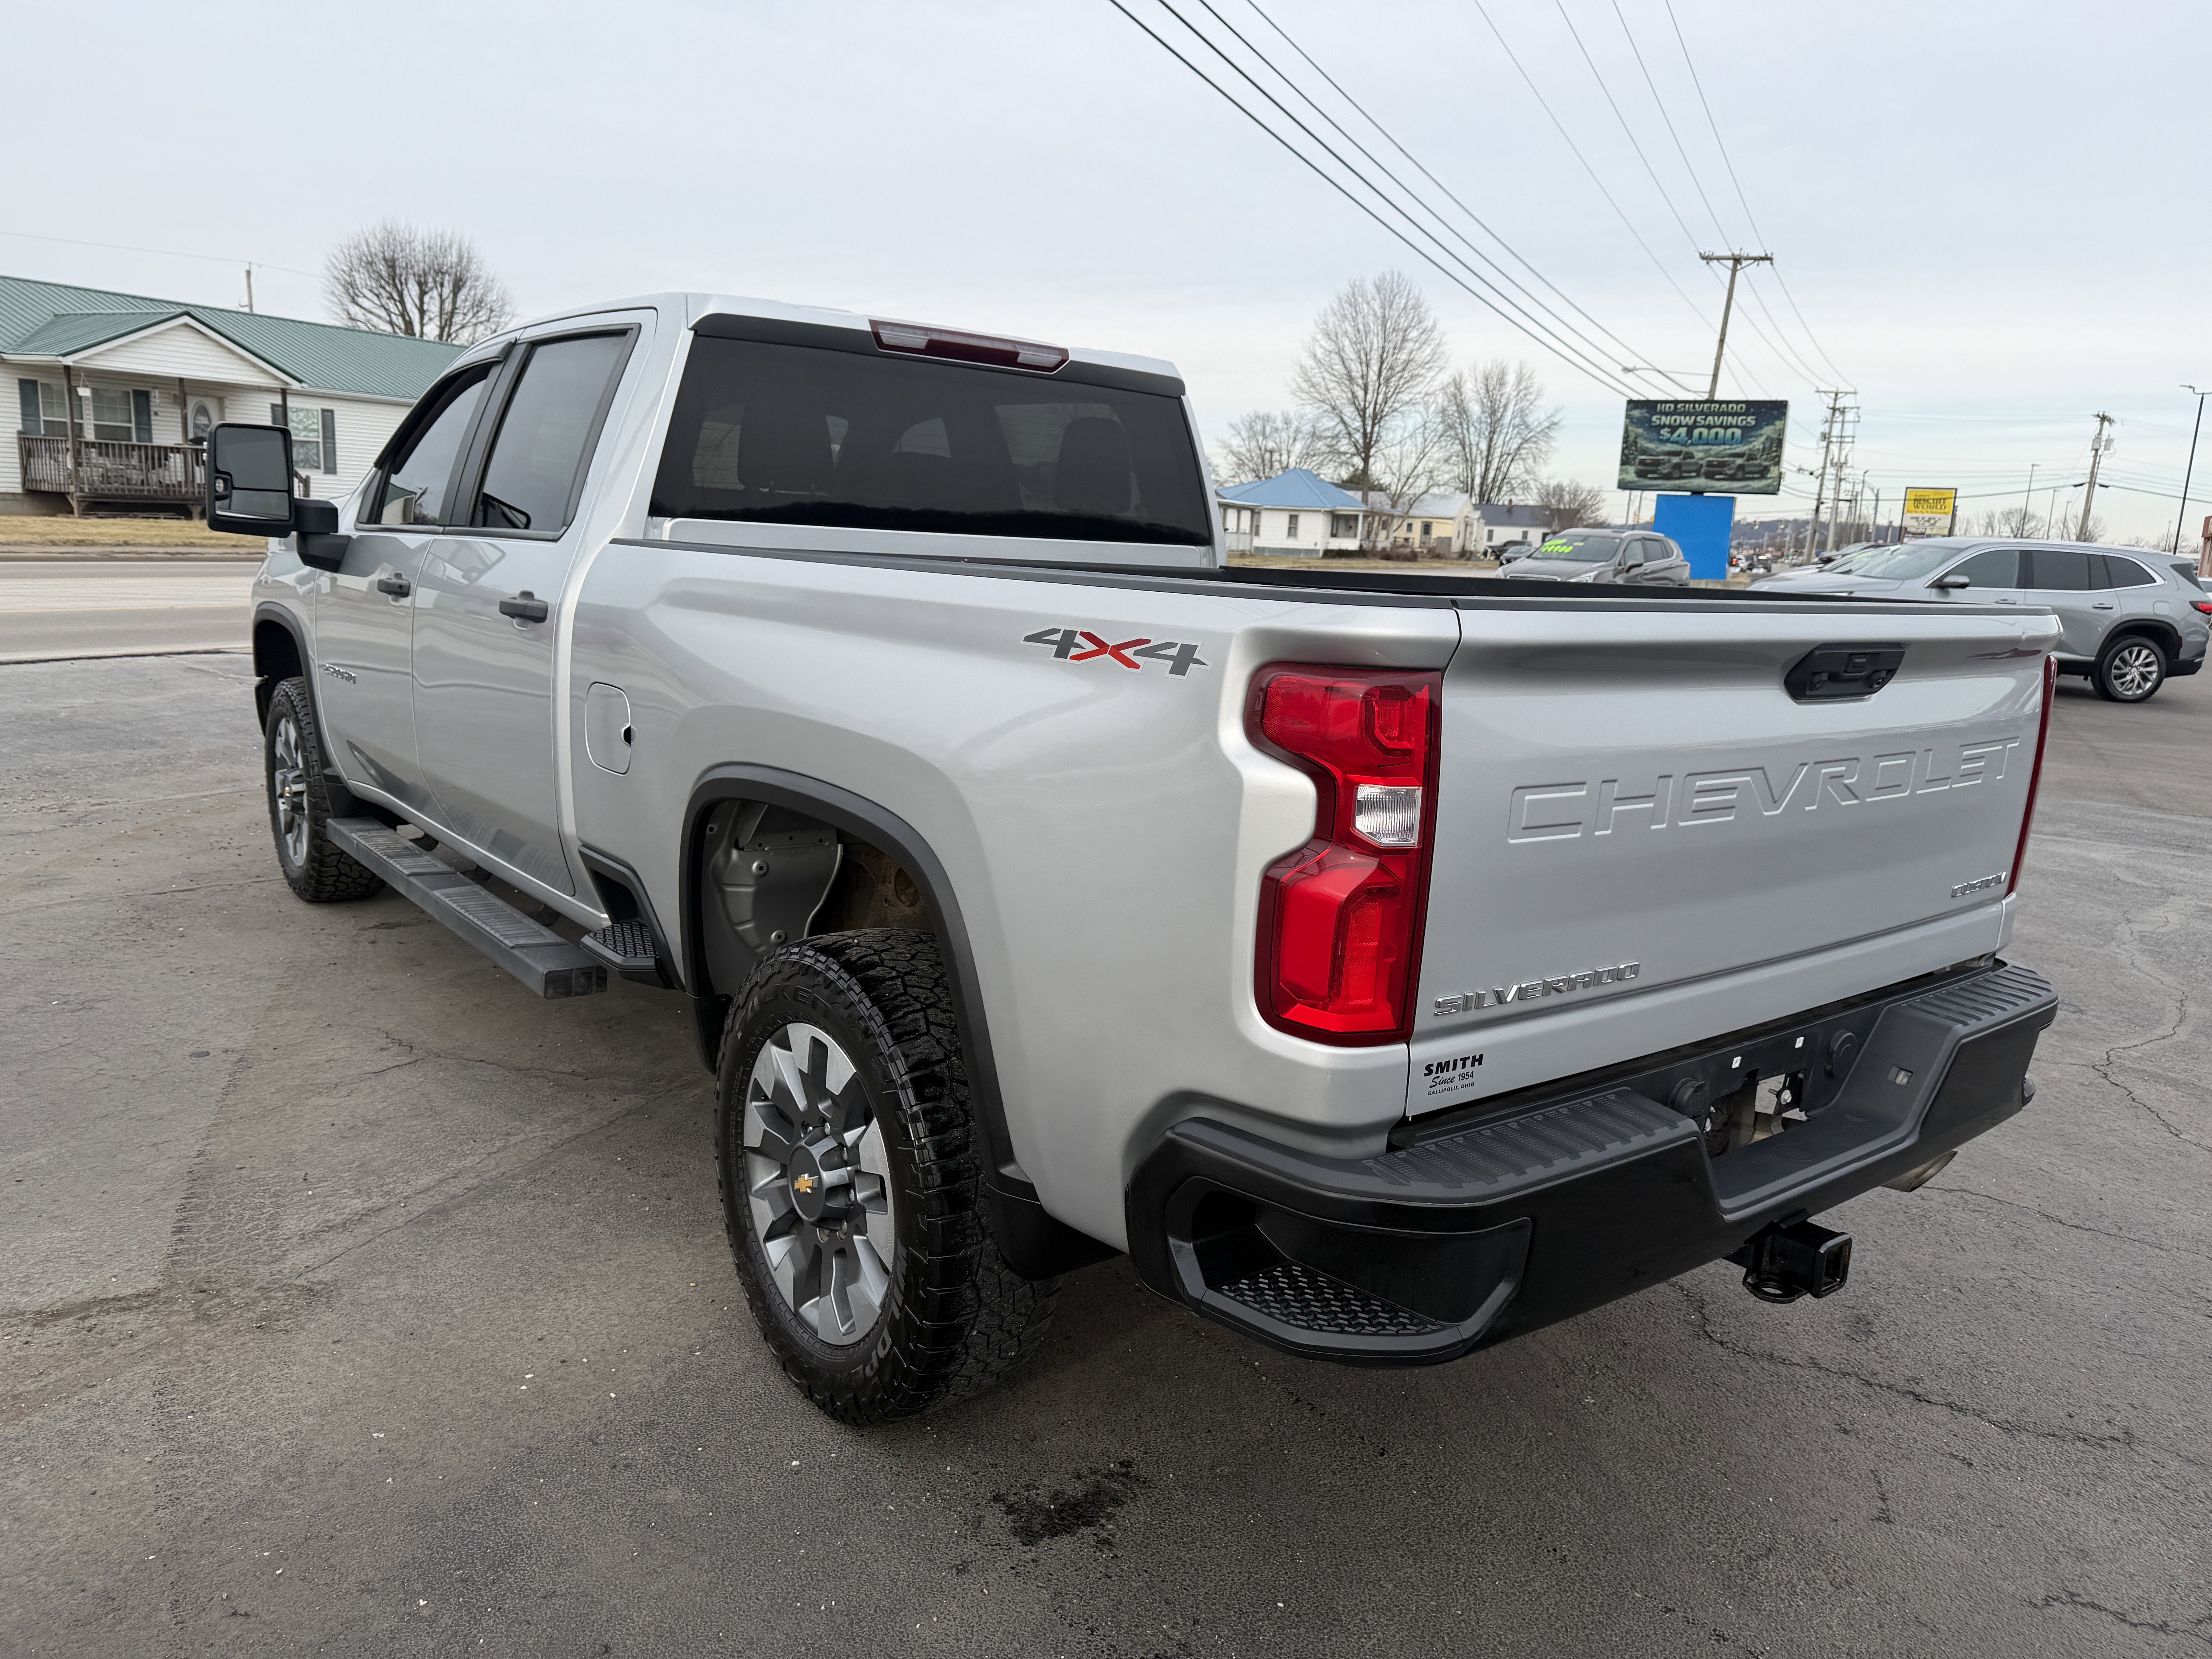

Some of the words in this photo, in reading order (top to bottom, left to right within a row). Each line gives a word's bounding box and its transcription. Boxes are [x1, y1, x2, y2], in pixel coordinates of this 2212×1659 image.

[1656, 403, 1674, 413] HD
[1676, 403, 1747, 413] SILVERADO
[1651, 415, 1696, 426] SNOW
[1696, 415, 1757, 426] SAVINGS
[1659, 426, 1742, 446] $4,000
[1507, 736, 2020, 843] CHEVROLET
[1433, 961, 1640, 1017] SILVERADO
[1424, 1053, 1484, 1077] SMITH
[1429, 1075, 1455, 1088] Since
[1458, 1071, 1474, 1081] 1954
[1427, 1085, 1460, 1096] GALLIPOLIS,
